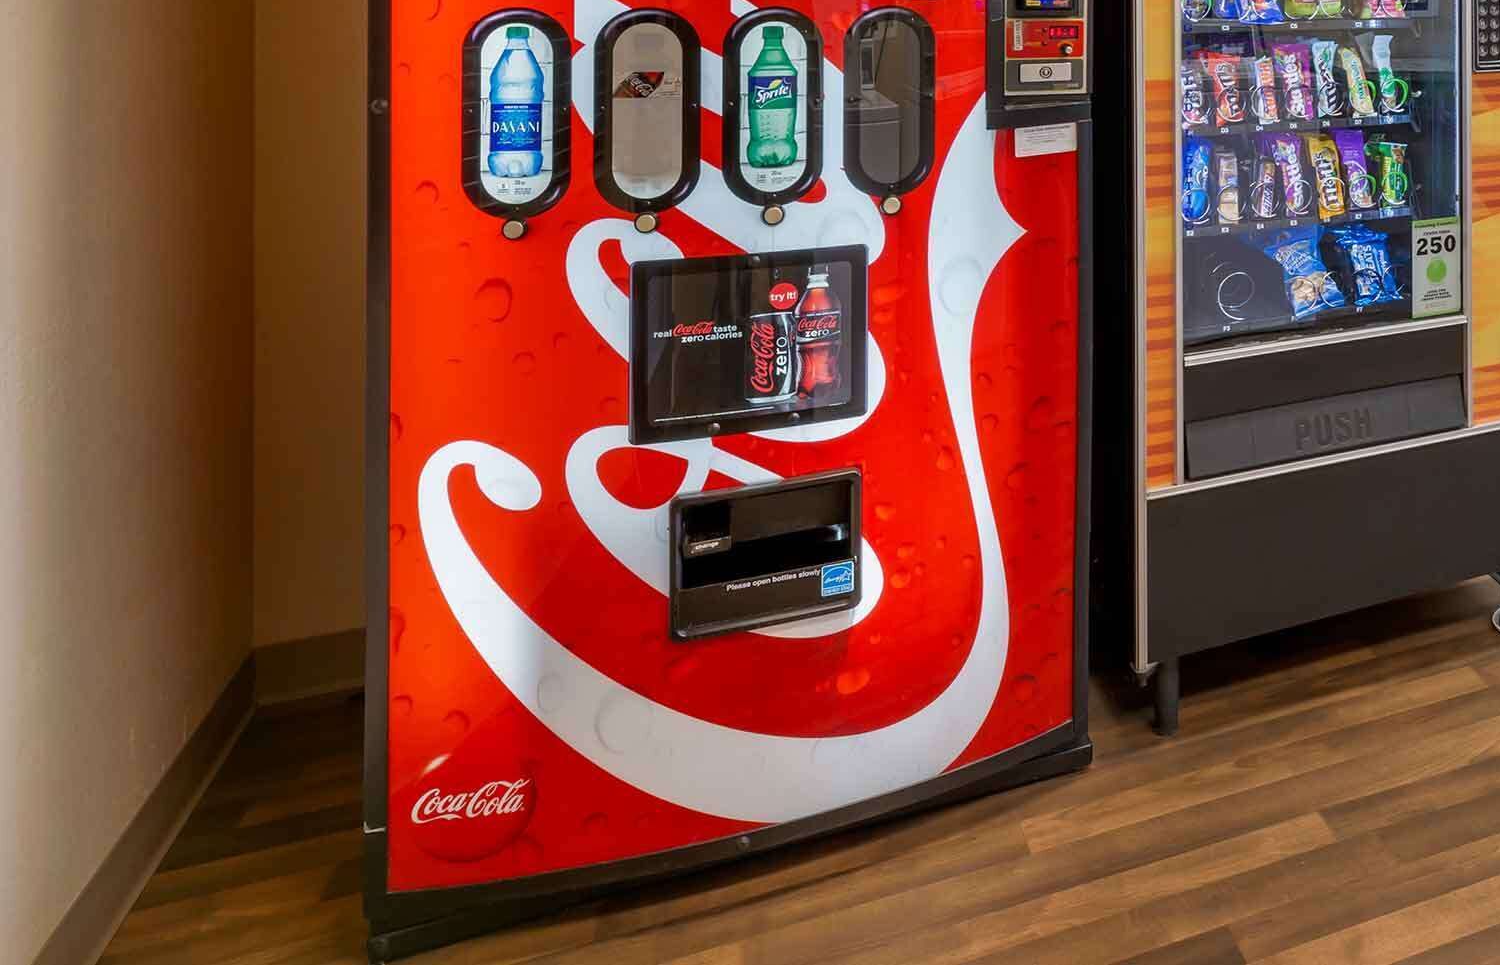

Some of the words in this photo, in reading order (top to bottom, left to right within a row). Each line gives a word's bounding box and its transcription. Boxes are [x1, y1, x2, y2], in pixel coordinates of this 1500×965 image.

[754, 85, 791, 104] Sprite
[492, 120, 540, 133] DASANI
[1416, 234, 1457, 256] 250
[770, 293, 785, 302] try
[786, 291, 797, 300] it!
[653, 329, 673, 338] real
[672, 321, 715, 337] Coca-Cola
[713, 324, 738, 333] taste
[797, 315, 838, 332] Coca-Cola
[681, 335, 705, 343] zero
[705, 331, 743, 341] calories
[805, 329, 830, 338] zero
[750, 321, 775, 393] Coca-Cola
[776, 336, 788, 376] zero
[1295, 407, 1371, 450] PUSH
[726, 581, 752, 592] Please
[752, 577, 771, 587] open
[772, 573, 797, 583] bottles
[798, 569, 821, 579] slowly
[411, 778, 531, 824] Coca-Cola
